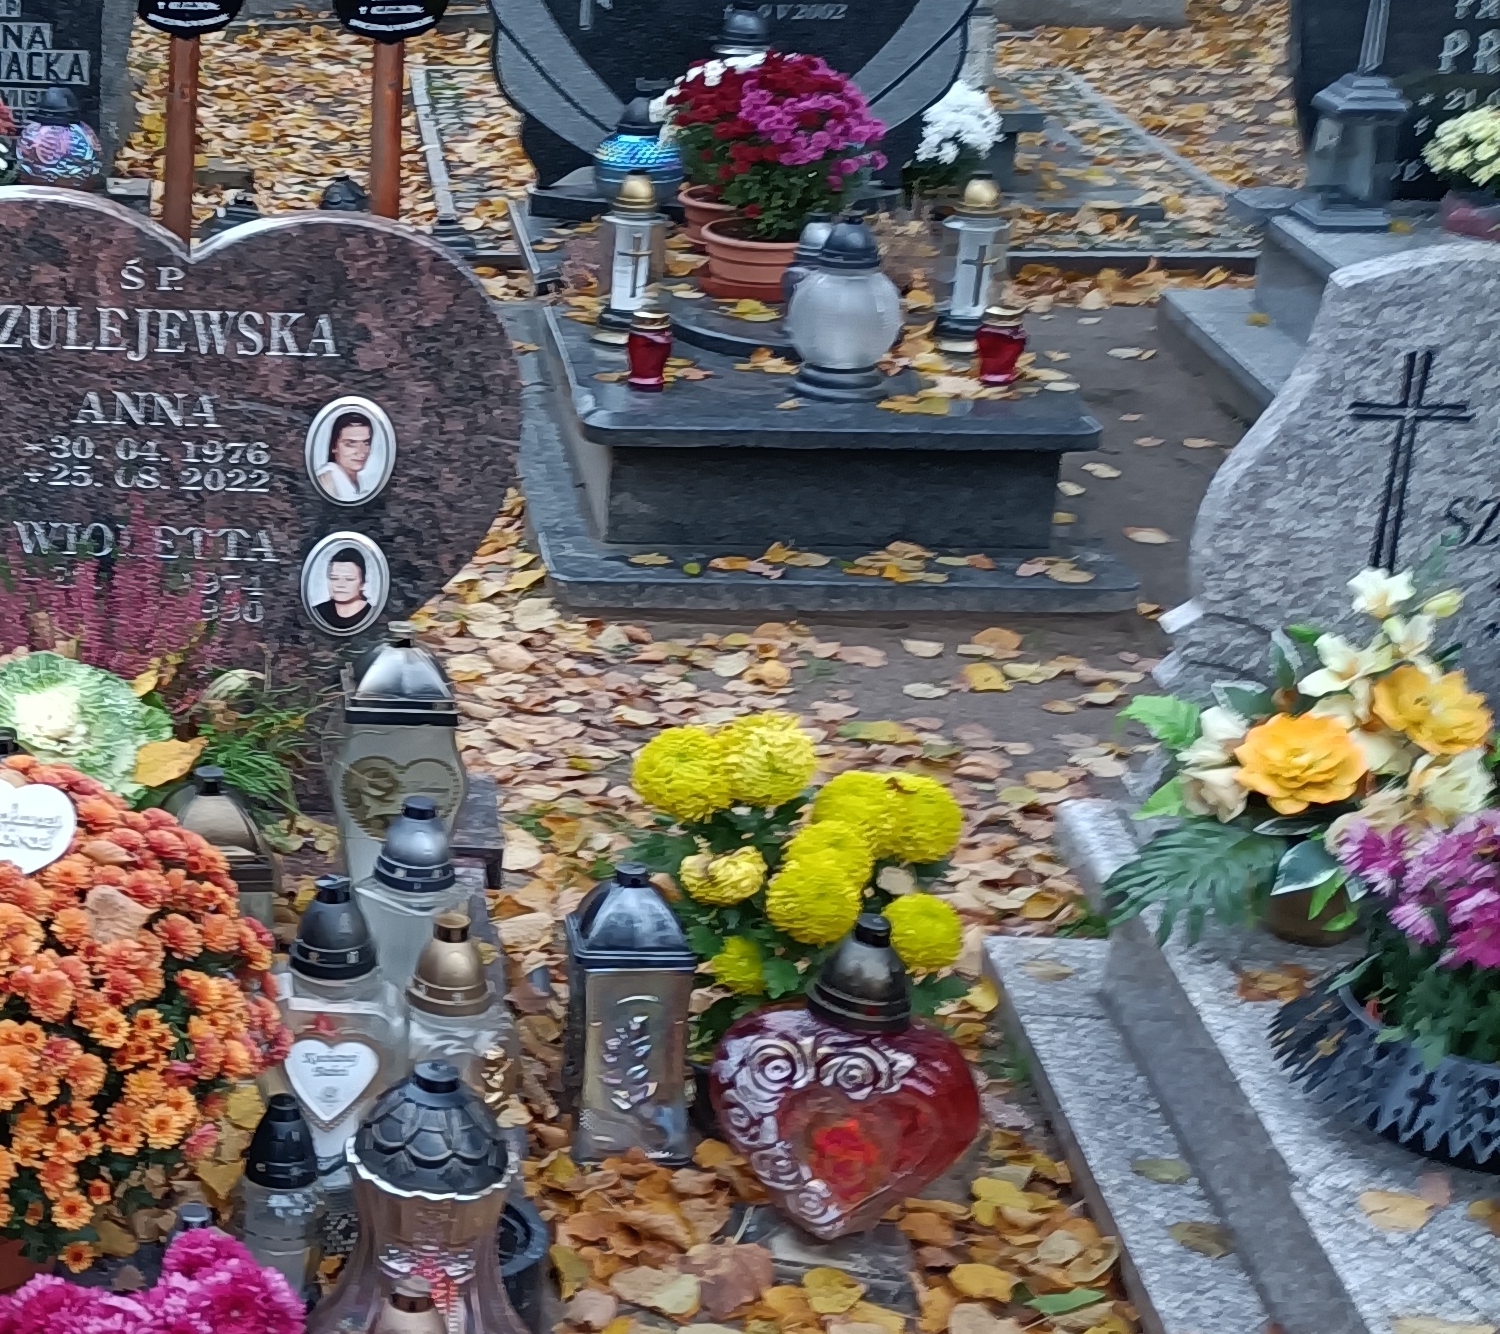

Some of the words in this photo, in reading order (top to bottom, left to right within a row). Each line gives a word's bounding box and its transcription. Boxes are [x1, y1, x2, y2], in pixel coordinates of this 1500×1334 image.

[70, 391, 222, 428] ANNA
[180, 439, 272, 465] 1976
[179, 467, 271, 492] 2022
